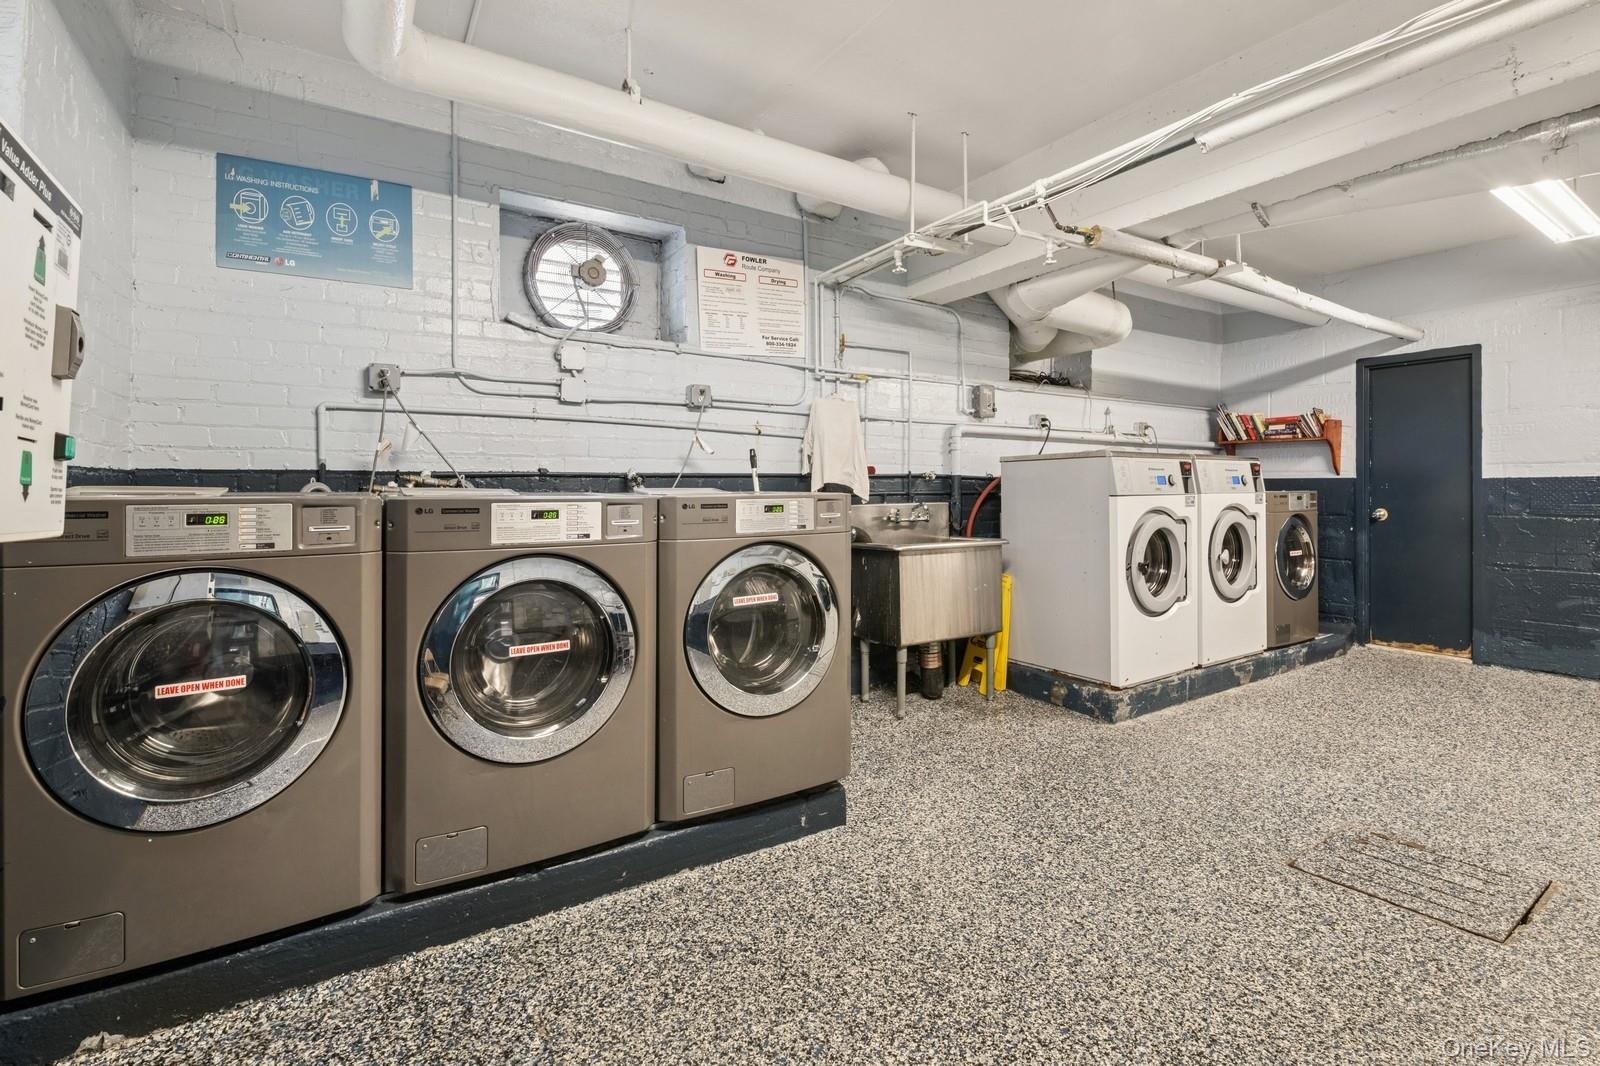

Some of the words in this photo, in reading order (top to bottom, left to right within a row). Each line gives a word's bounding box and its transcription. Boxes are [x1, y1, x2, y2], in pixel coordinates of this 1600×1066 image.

[1, 137, 20, 168] Value
[20, 160, 39, 186] Adder
[38, 180, 52, 202] Plus
[224, 173, 234, 181] LG
[236, 175, 269, 186] WASHING
[270, 181, 320, 194] INSTRUCTIONS
[285, 259, 296, 267] LG
[741, 255, 767, 264] FOWLER
[714, 271, 736, 280] Washing
[757, 265, 781, 275] Company
[511, 646, 526, 655] LEAVE
[526, 645, 540, 653] OPEN
[540, 643, 556, 651] WHEN
[556, 641, 569, 649] DONE
[157, 685, 179, 696] LEAVE
[180, 683, 200, 693] OPEN
[201, 680, 224, 690] WHEN
[225, 677, 245, 687] DONE
